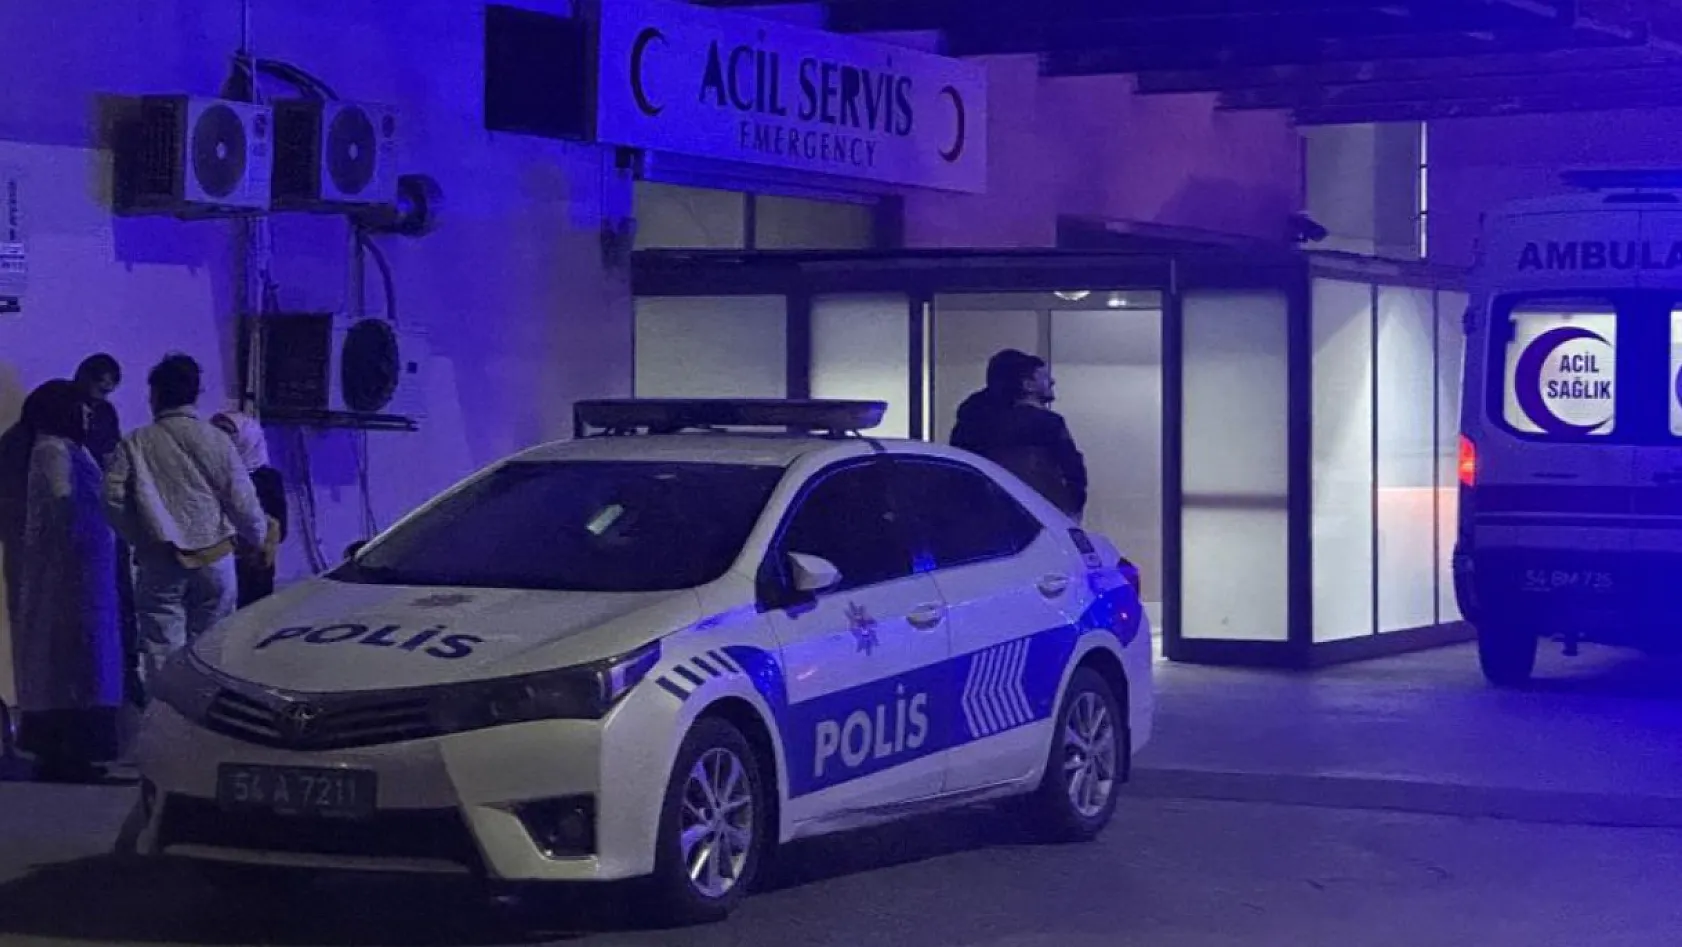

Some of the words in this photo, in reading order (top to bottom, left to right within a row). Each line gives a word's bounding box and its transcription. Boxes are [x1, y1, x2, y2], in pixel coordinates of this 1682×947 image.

[700, 29, 787, 117] ACİL
[799, 55, 914, 137] SERVİS
[739, 119, 880, 168] EMERGENCY
[1560, 350, 1600, 374] ACİL
[1546, 376, 1612, 400] SAĞLIK
[253, 623, 485, 659] POLİS
[814, 682, 929, 778] POLİS
